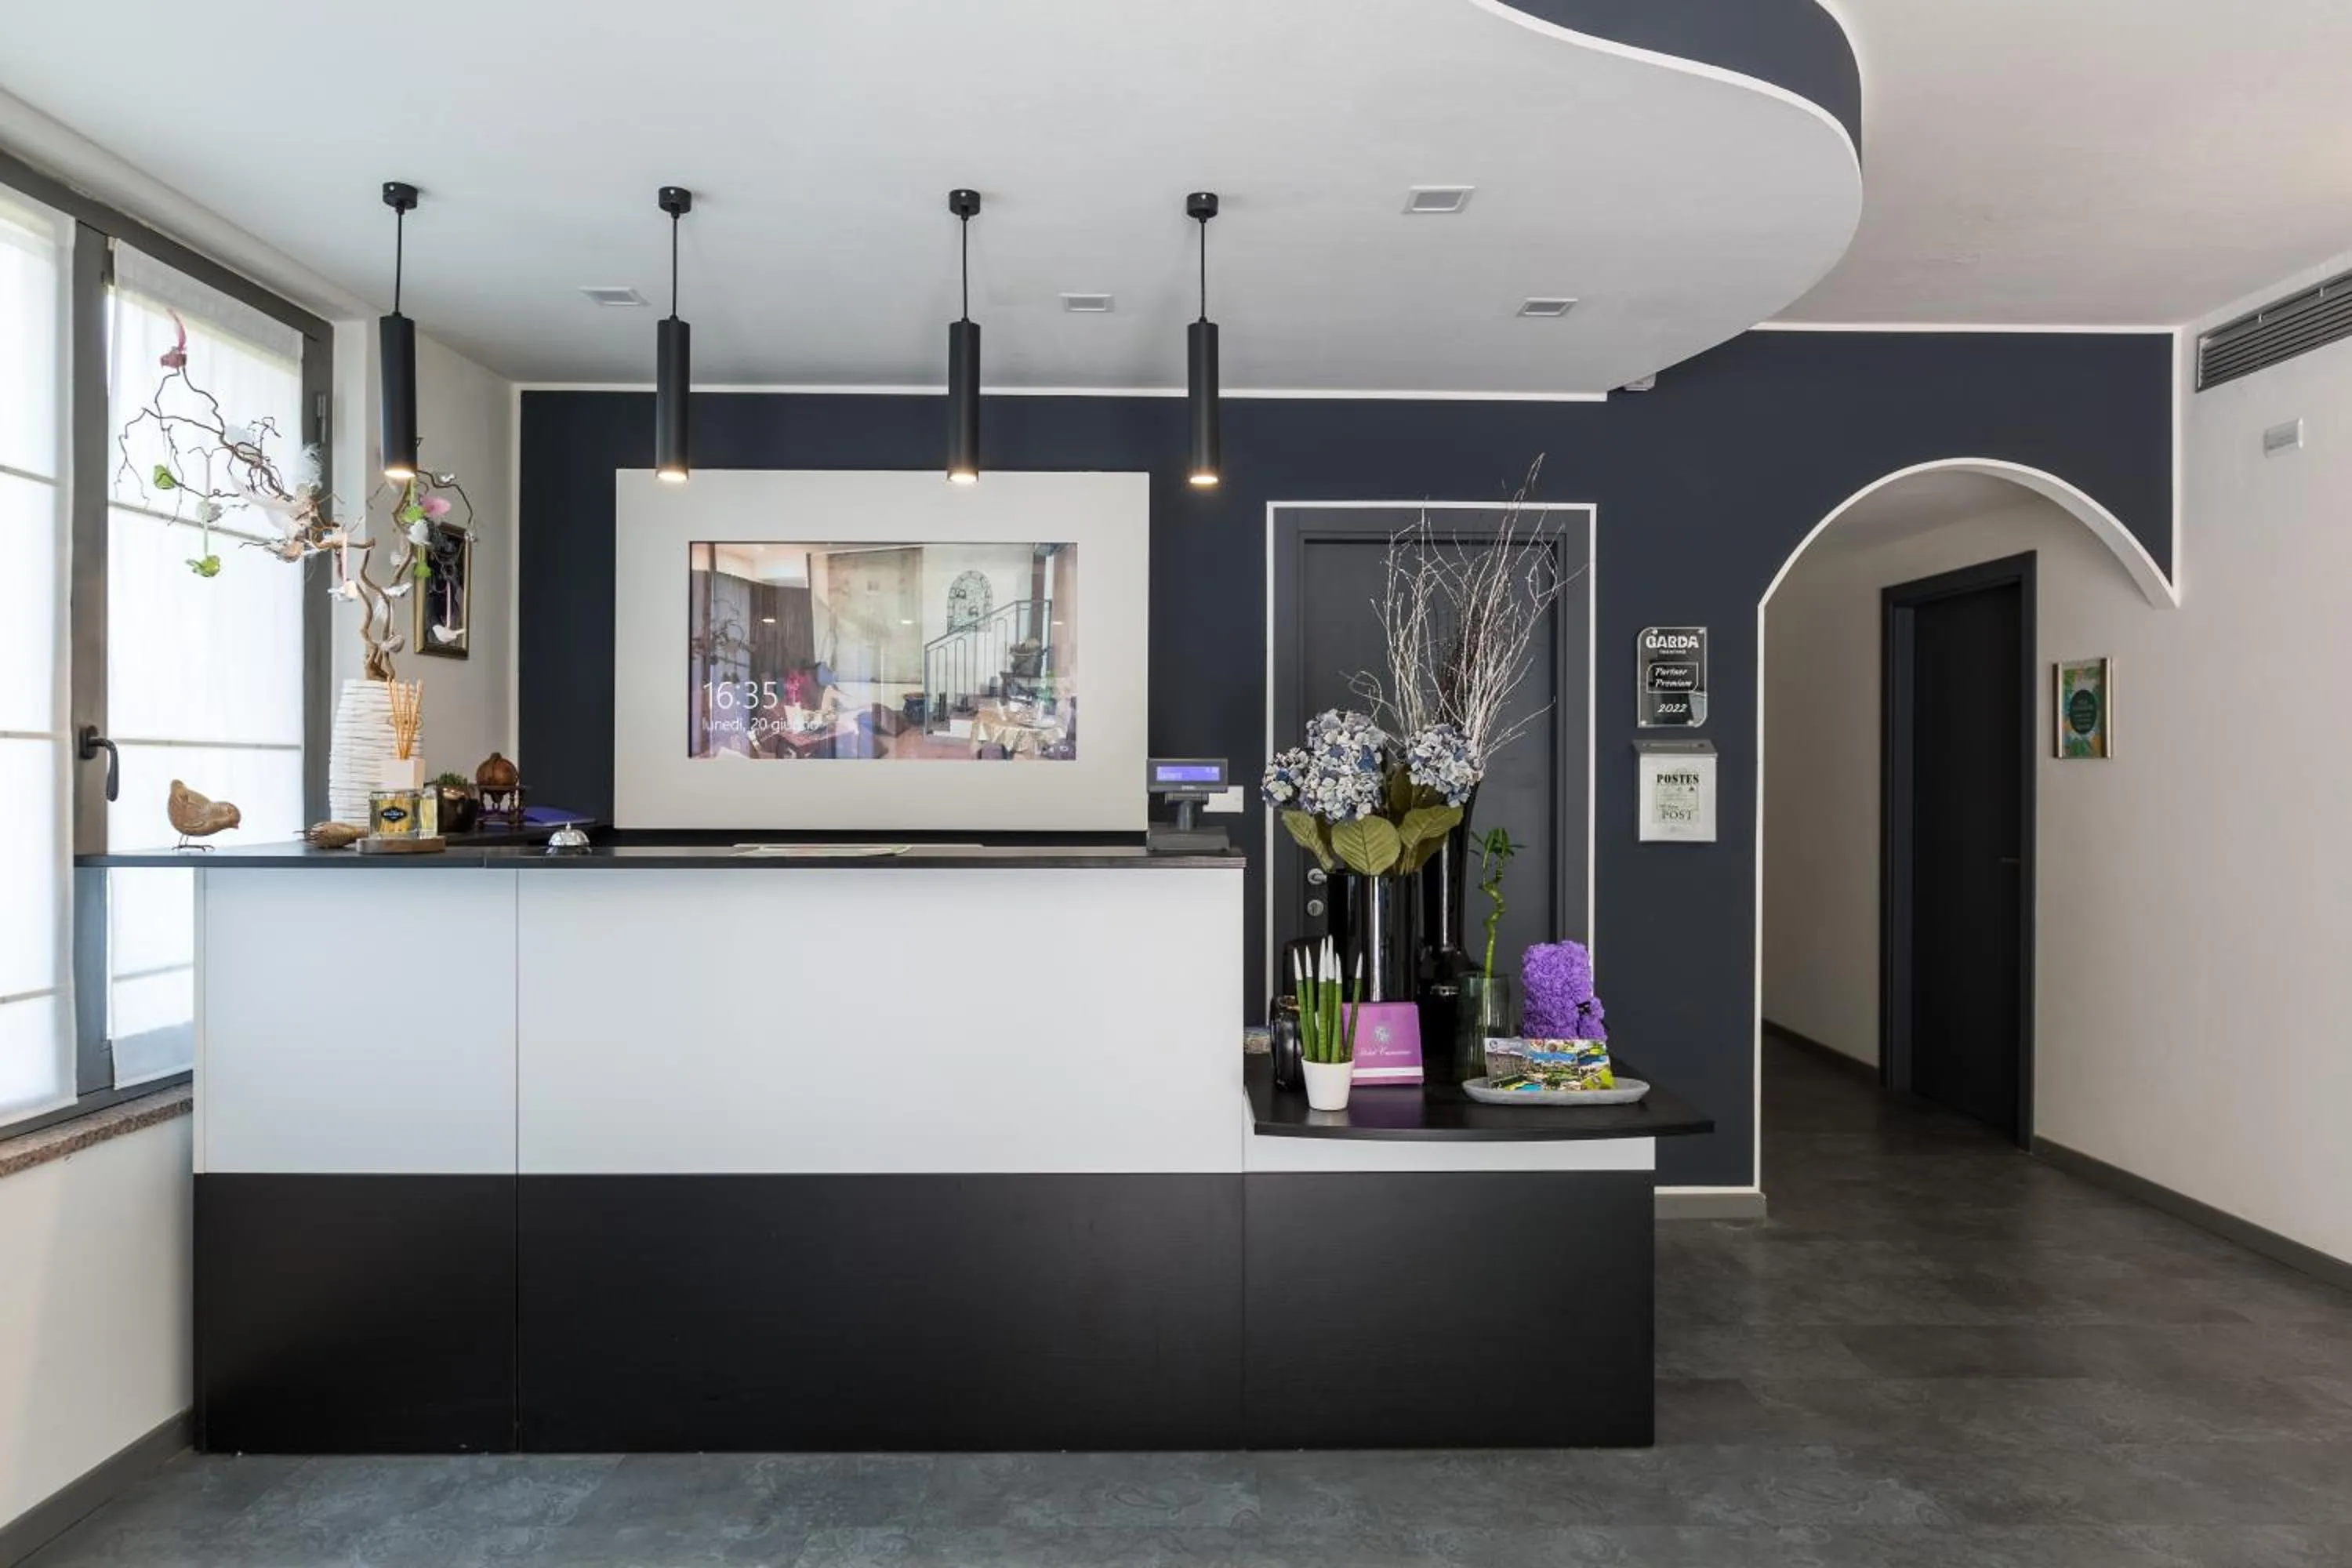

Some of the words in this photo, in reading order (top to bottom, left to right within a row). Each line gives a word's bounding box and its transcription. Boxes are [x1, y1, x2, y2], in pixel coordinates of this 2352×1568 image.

[1646, 636, 1699, 648] GARDA
[1655, 667, 1687, 677] Partner
[1655, 678, 1692, 688] Premium
[703, 681, 778, 710] 16:35
[1657, 703, 1687, 713] 2022
[750, 717, 768, 730] 20
[1657, 774, 1699, 784] POSTES
[1661, 809, 1692, 819] POST
